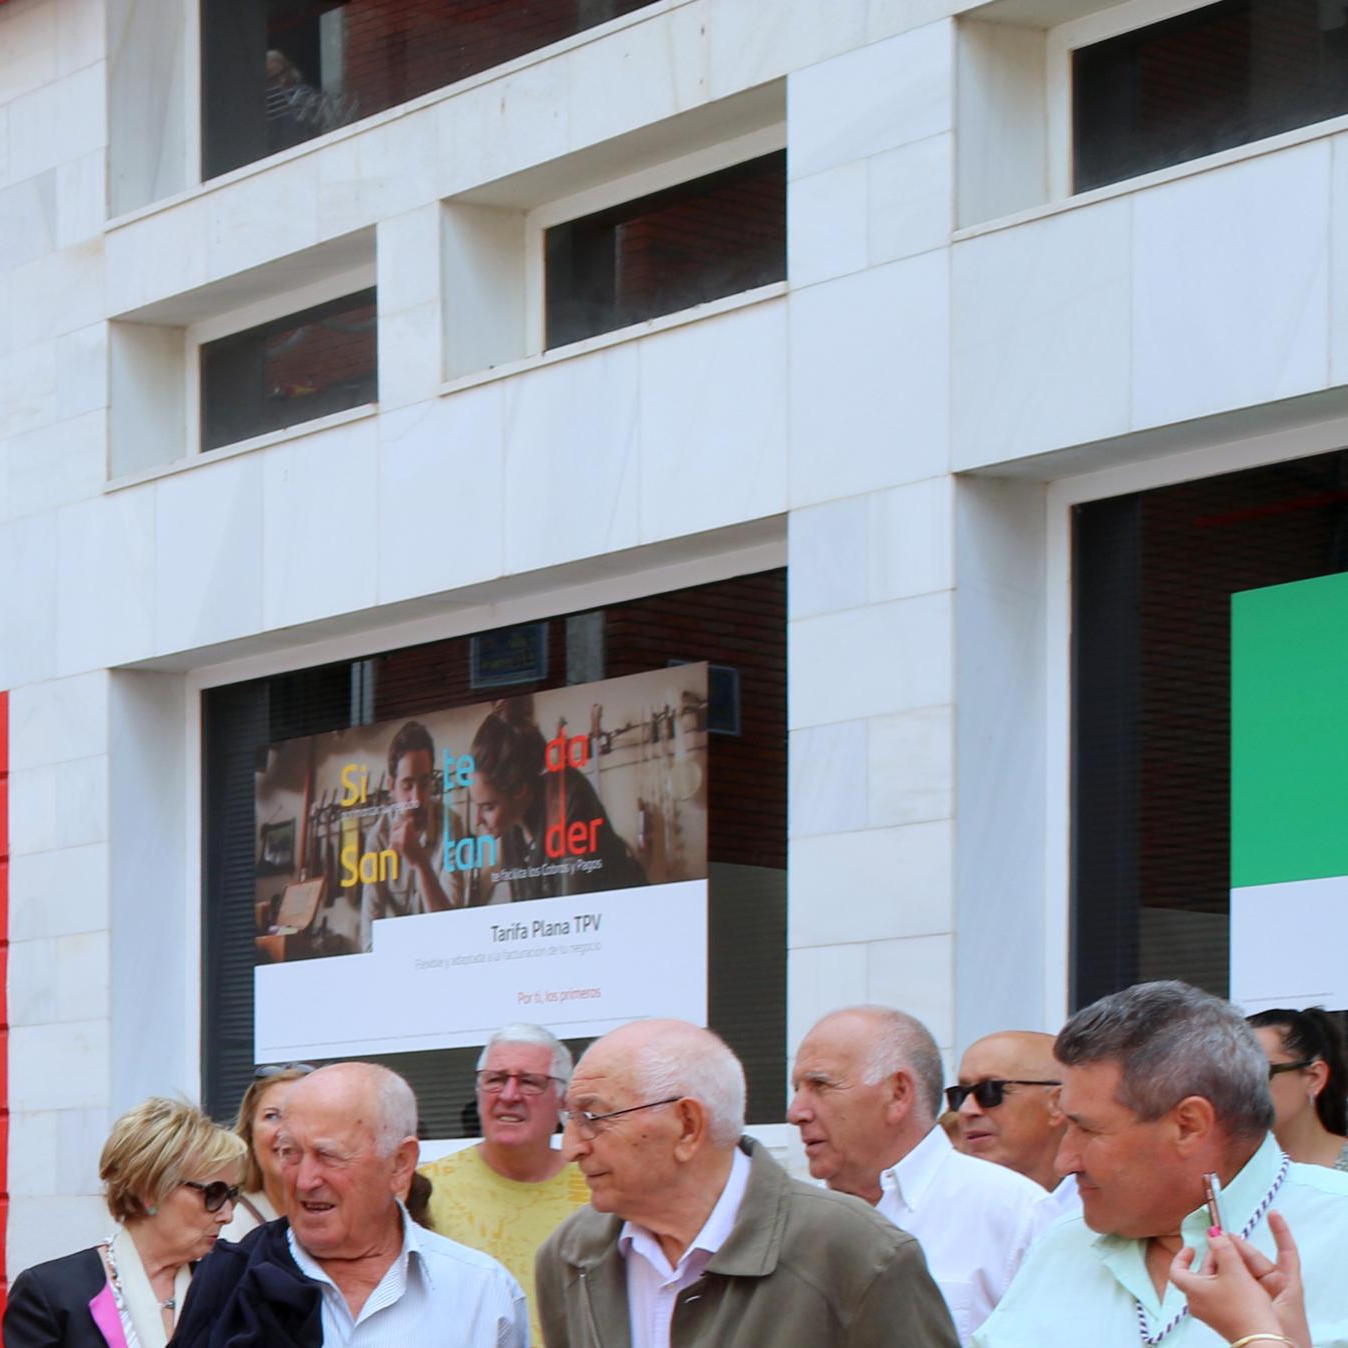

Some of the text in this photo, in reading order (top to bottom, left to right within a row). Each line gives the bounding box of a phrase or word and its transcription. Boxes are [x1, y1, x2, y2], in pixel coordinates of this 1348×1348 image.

[339, 724, 589, 808] Si te da
[339, 815, 604, 888] San tan der
[576, 859, 603, 874] Pagos
[490, 913, 603, 943] Tarifa Plana TPV
[545, 988, 559, 1003] los
[560, 986, 602, 1004] primeros
